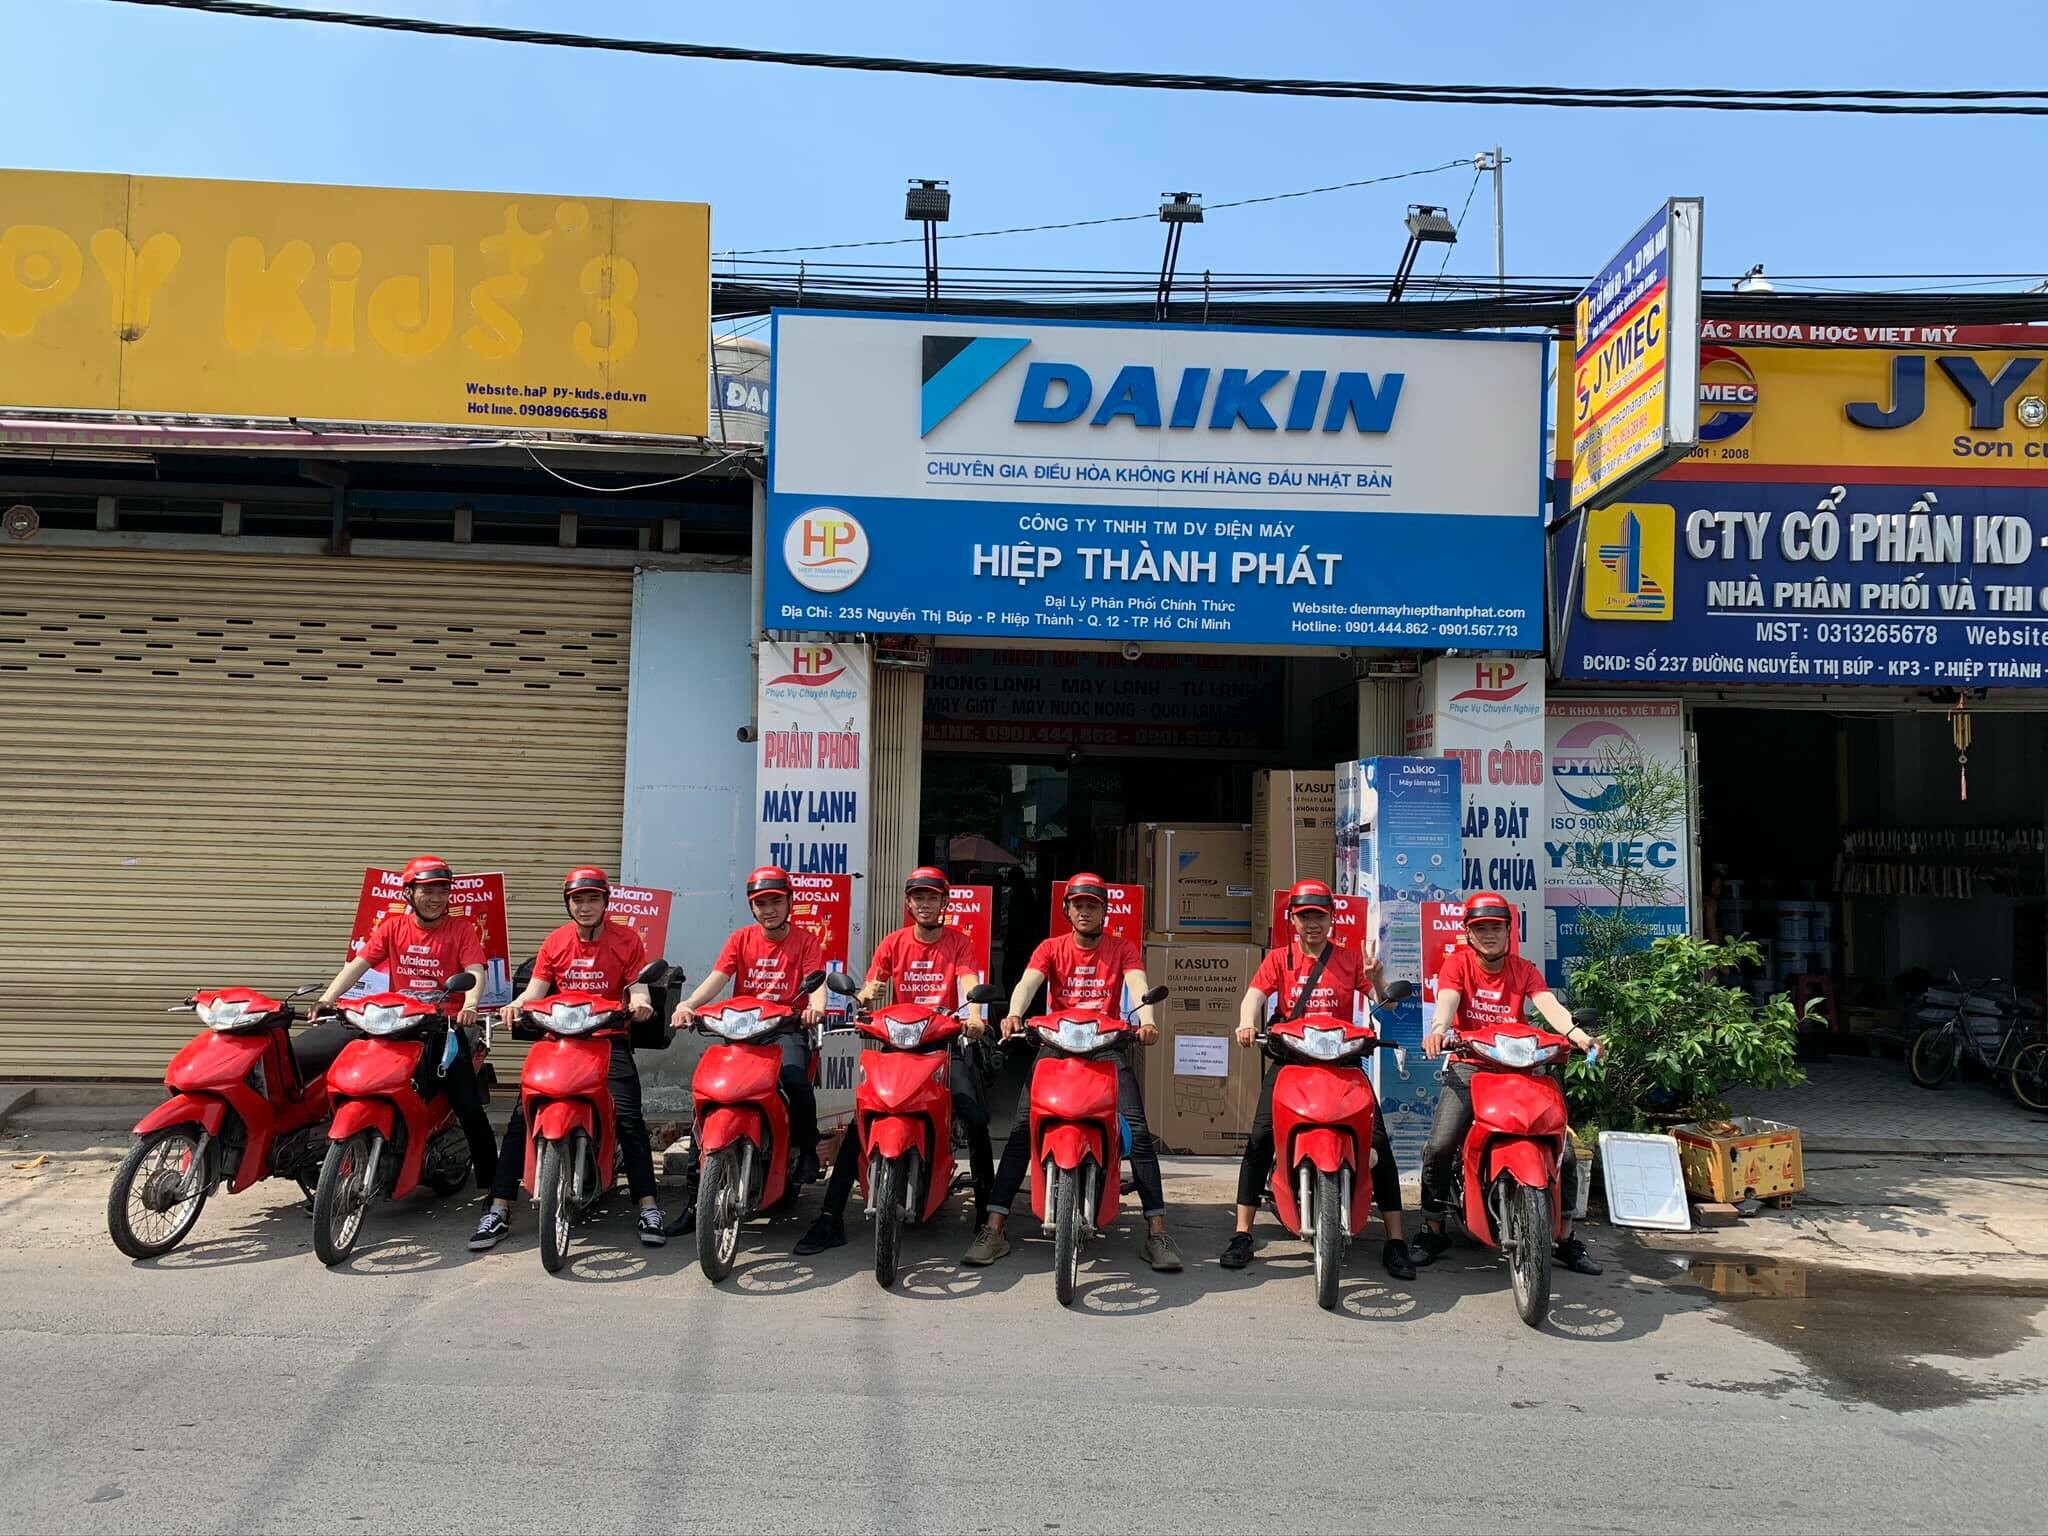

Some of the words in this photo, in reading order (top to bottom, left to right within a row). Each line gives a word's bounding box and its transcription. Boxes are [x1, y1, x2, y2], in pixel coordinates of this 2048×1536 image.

[574, 253, 639, 364] 3
[1701, 320, 1732, 338] ÁC
[1738, 324, 1804, 340] KHOA
[1593, 303, 1661, 395] JYMEC
[1014, 361, 1405, 433] DAIKIN
[1700, 384, 1756, 401] MEC
[519, 404, 608, 420] 0908966568
[1721, 448, 1749, 459] 2008
[1952, 435, 2014, 457] Sơn
[926, 460, 995, 478] CHUYÊN
[999, 464, 1028, 478] GIA
[1076, 463, 1111, 481] HÒA
[1116, 465, 1176, 483] KHÔNG
[1181, 466, 1209, 484] KHÍ
[1213, 467, 1262, 486] HÀNG
[1018, 512, 1069, 532] CÔNG
[1074, 519, 1097, 533] TY
[1102, 519, 1147, 534] TNHH
[1153, 521, 1177, 535] TM
[1183, 522, 1208, 536] DV
[1214, 519, 1253, 540] ĐIỆN
[1259, 520, 1295, 538] MÁY
[1685, 508, 1772, 561] CTY
[1780, 485, 1847, 562] CỔ
[1849, 491, 1963, 564] PHẦN
[1972, 515, 2033, 565] KD
[973, 541, 1062, 586] HIỆP
[1077, 541, 1217, 583] THÀNH
[1231, 545, 1342, 586] PHÁT
[1706, 573, 1765, 607] NHÀ
[1773, 575, 1851, 609] PHÂN
[1860, 572, 1930, 610] PHỐI
[1937, 576, 1977, 612] VÀ
[1984, 585, 2033, 612] THI
[1044, 595, 1066, 610] Đại
[1070, 596, 1087, 611] Lý
[1091, 597, 1124, 610] Phân
[1127, 595, 1157, 610] Phối
[1160, 598, 1197, 611] Chính
[1202, 599, 1236, 613] Thức
[1292, 602, 1347, 615] Website:
[781, 605, 803, 620] Địa
[839, 607, 863, 619] 235
[921, 609, 941, 625] Thị
[946, 610, 973, 626] Búp
[1001, 612, 1030, 627] Hiệp
[1034, 612, 1074, 626] Thành
[1087, 615, 1102, 627] Q.
[1106, 615, 1120, 628] 12
[1154, 614, 1172, 629] Hồ
[1177, 616, 1199, 630] Chí
[1201, 618, 1232, 631] Minh
[1292, 620, 1341, 633] Hotline:
[1345, 622, 1429, 635] 0901.444.862
[1438, 623, 1519, 637] 0901.567.713
[1755, 622, 1808, 642] MST:
[1816, 623, 1938, 645] 0313265678
[1582, 654, 1631, 671] ĐCKD:
[1634, 649, 1657, 672] SỐ
[1659, 656, 1689, 672] 237
[1692, 652, 1744, 673] ĐƯỜNG
[1747, 652, 1809, 675] NGUYỄN
[1813, 659, 1839, 680] THỊ
[1842, 656, 1874, 676] BÚP
[1888, 660, 1921, 676] KP3
[1934, 658, 1984, 682] P.HIỆP
[1988, 658, 2042, 679] THÀNH
[1569, 706, 1601, 716] KHOA
[763, 721, 813, 769] PHÂN
[817, 717, 861, 770] PHỐI
[925, 724, 980, 741] LINE:
[1488, 740, 1544, 786] CÔNG
[1295, 782, 1335, 793] KASUT
[762, 783, 804, 823] MÁY
[807, 790, 857, 832] LẠNH
[1461, 793, 1489, 838] ẮP
[1494, 799, 1529, 848] ĐẶT
[1551, 817, 1576, 830] ISO
[1544, 841, 1678, 869] YMEC
[400, 955, 440, 968] Makano
[1174, 958, 1229, 969] KASUTO
[904, 971, 944, 982] Makano
